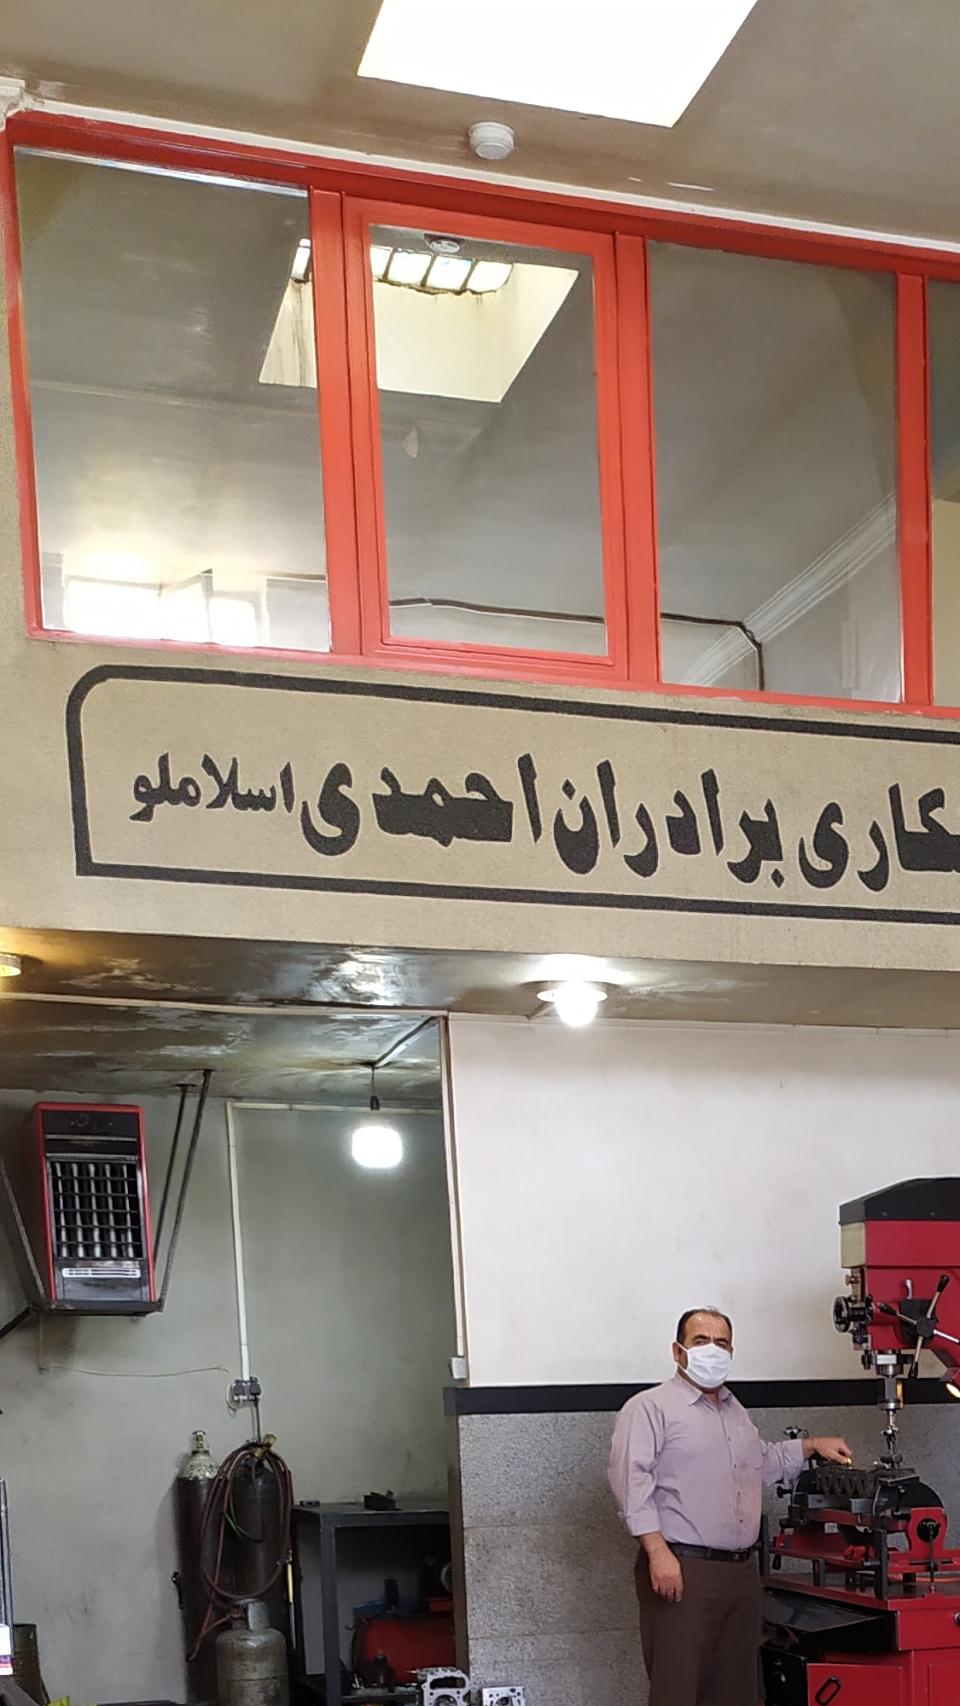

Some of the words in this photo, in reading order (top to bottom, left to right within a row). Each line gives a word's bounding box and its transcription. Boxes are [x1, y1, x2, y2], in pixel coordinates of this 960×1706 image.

[129, 752, 295, 822] اسلاملو
[300, 753, 542, 857] احمدی
[553, 758, 785, 888] برادران
